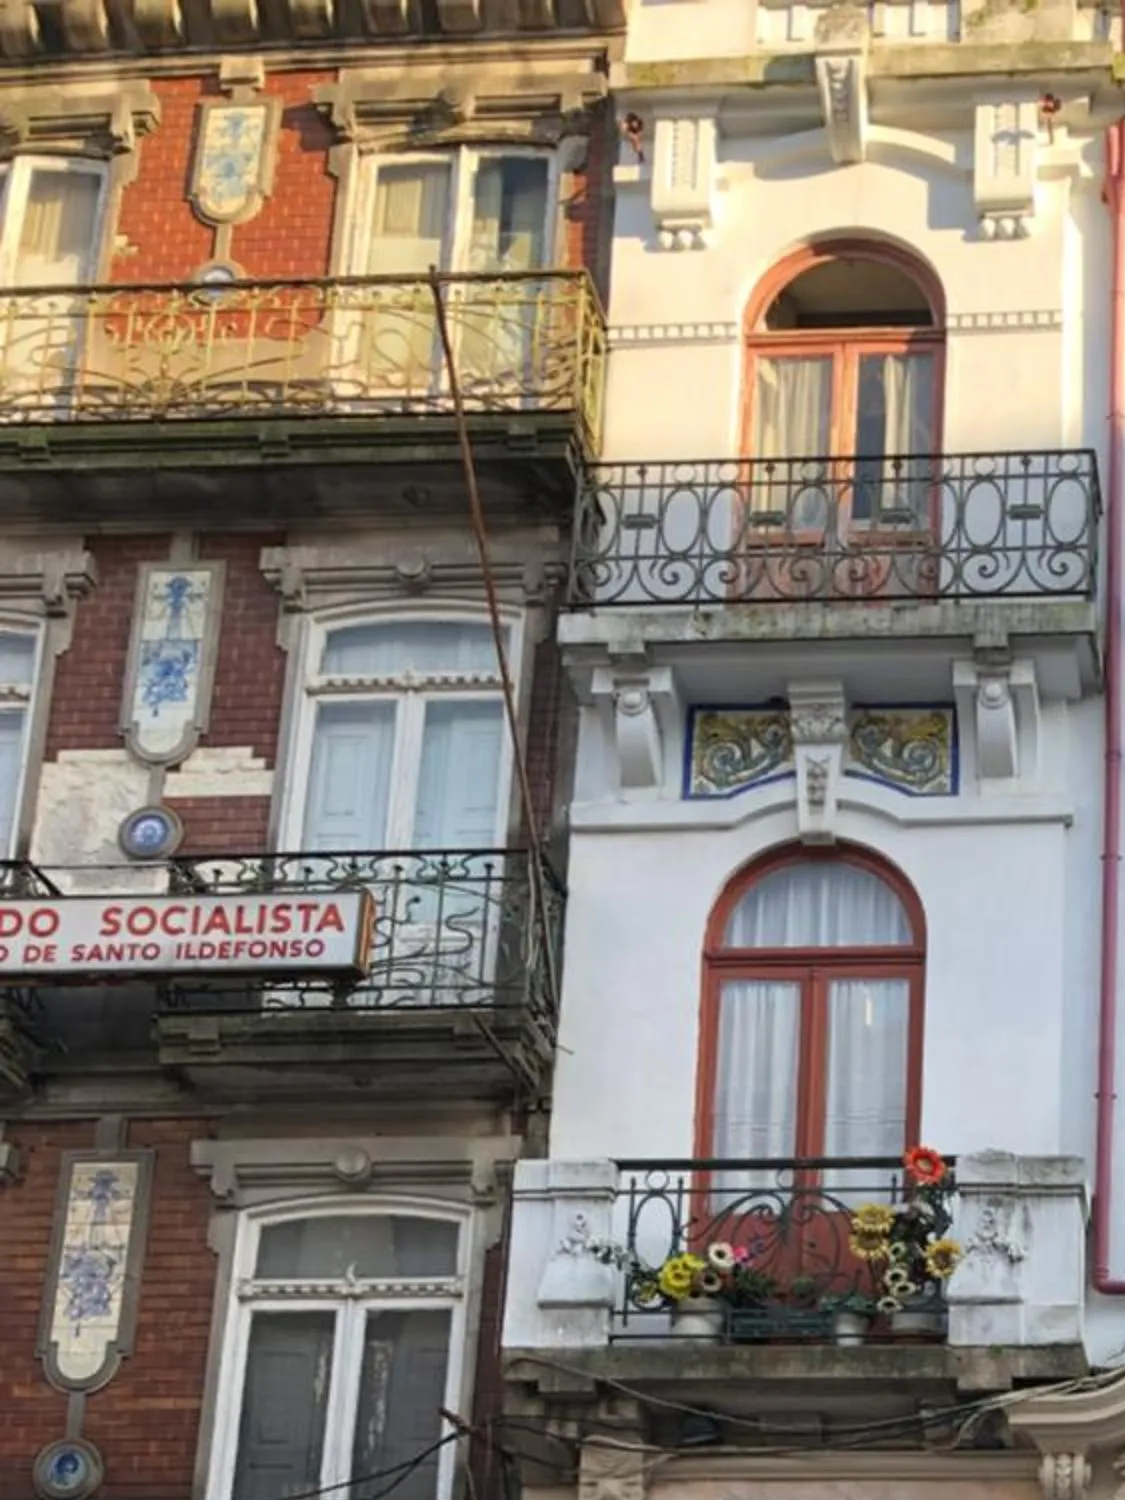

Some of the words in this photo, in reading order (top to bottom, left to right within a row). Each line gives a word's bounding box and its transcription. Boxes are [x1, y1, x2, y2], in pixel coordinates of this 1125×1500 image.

[0, 908, 59, 937] DO
[100, 903, 345, 936] SOCIALISTA
[23, 945, 56, 963] DE
[72, 943, 161, 962] SANTO
[175, 939, 326, 961] ILDEFONSO
